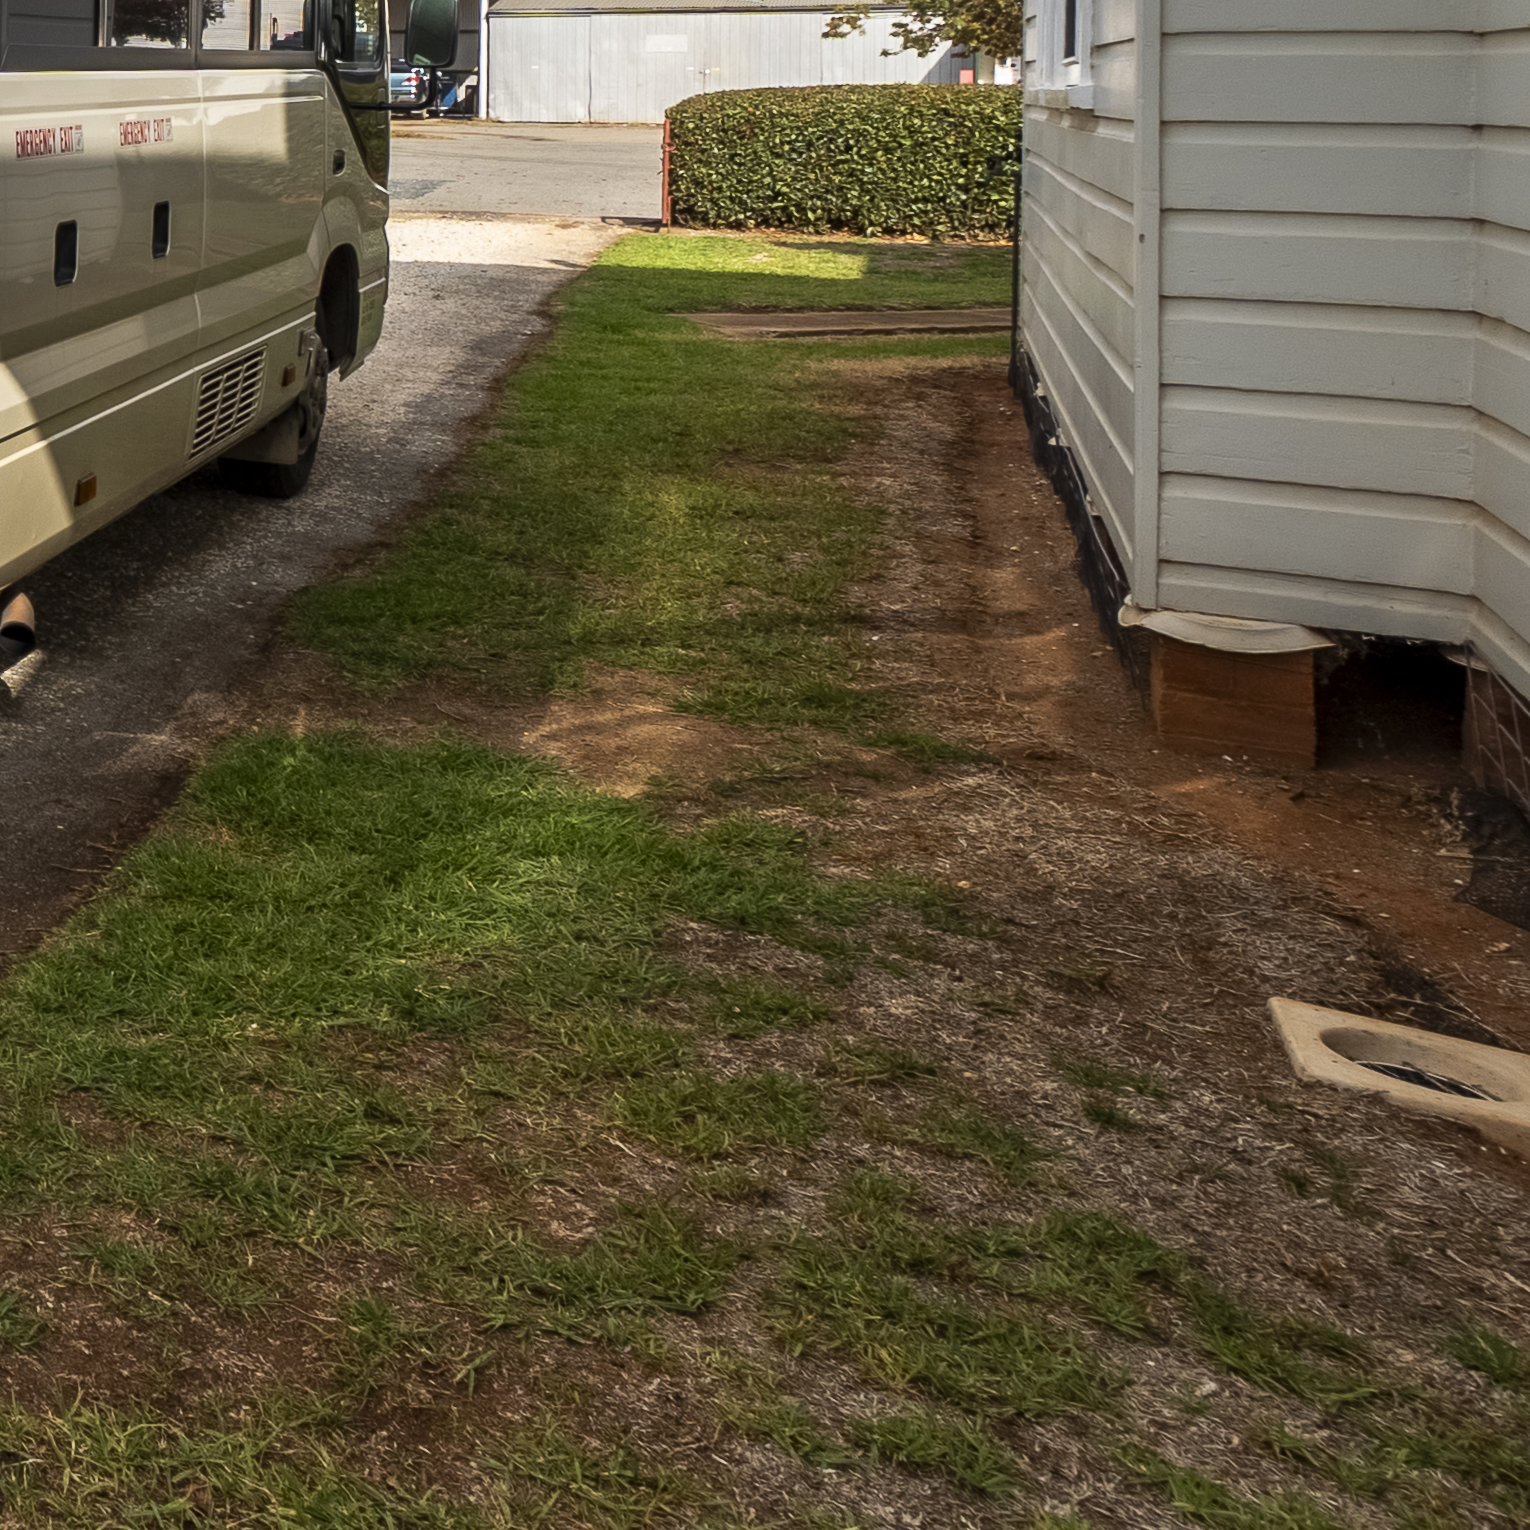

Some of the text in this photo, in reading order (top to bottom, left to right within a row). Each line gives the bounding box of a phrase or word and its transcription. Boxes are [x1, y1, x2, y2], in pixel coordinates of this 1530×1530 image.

[15, 126, 74, 158] EMERGENCY EXIT
[120, 120, 151, 146] EMERGENCY
